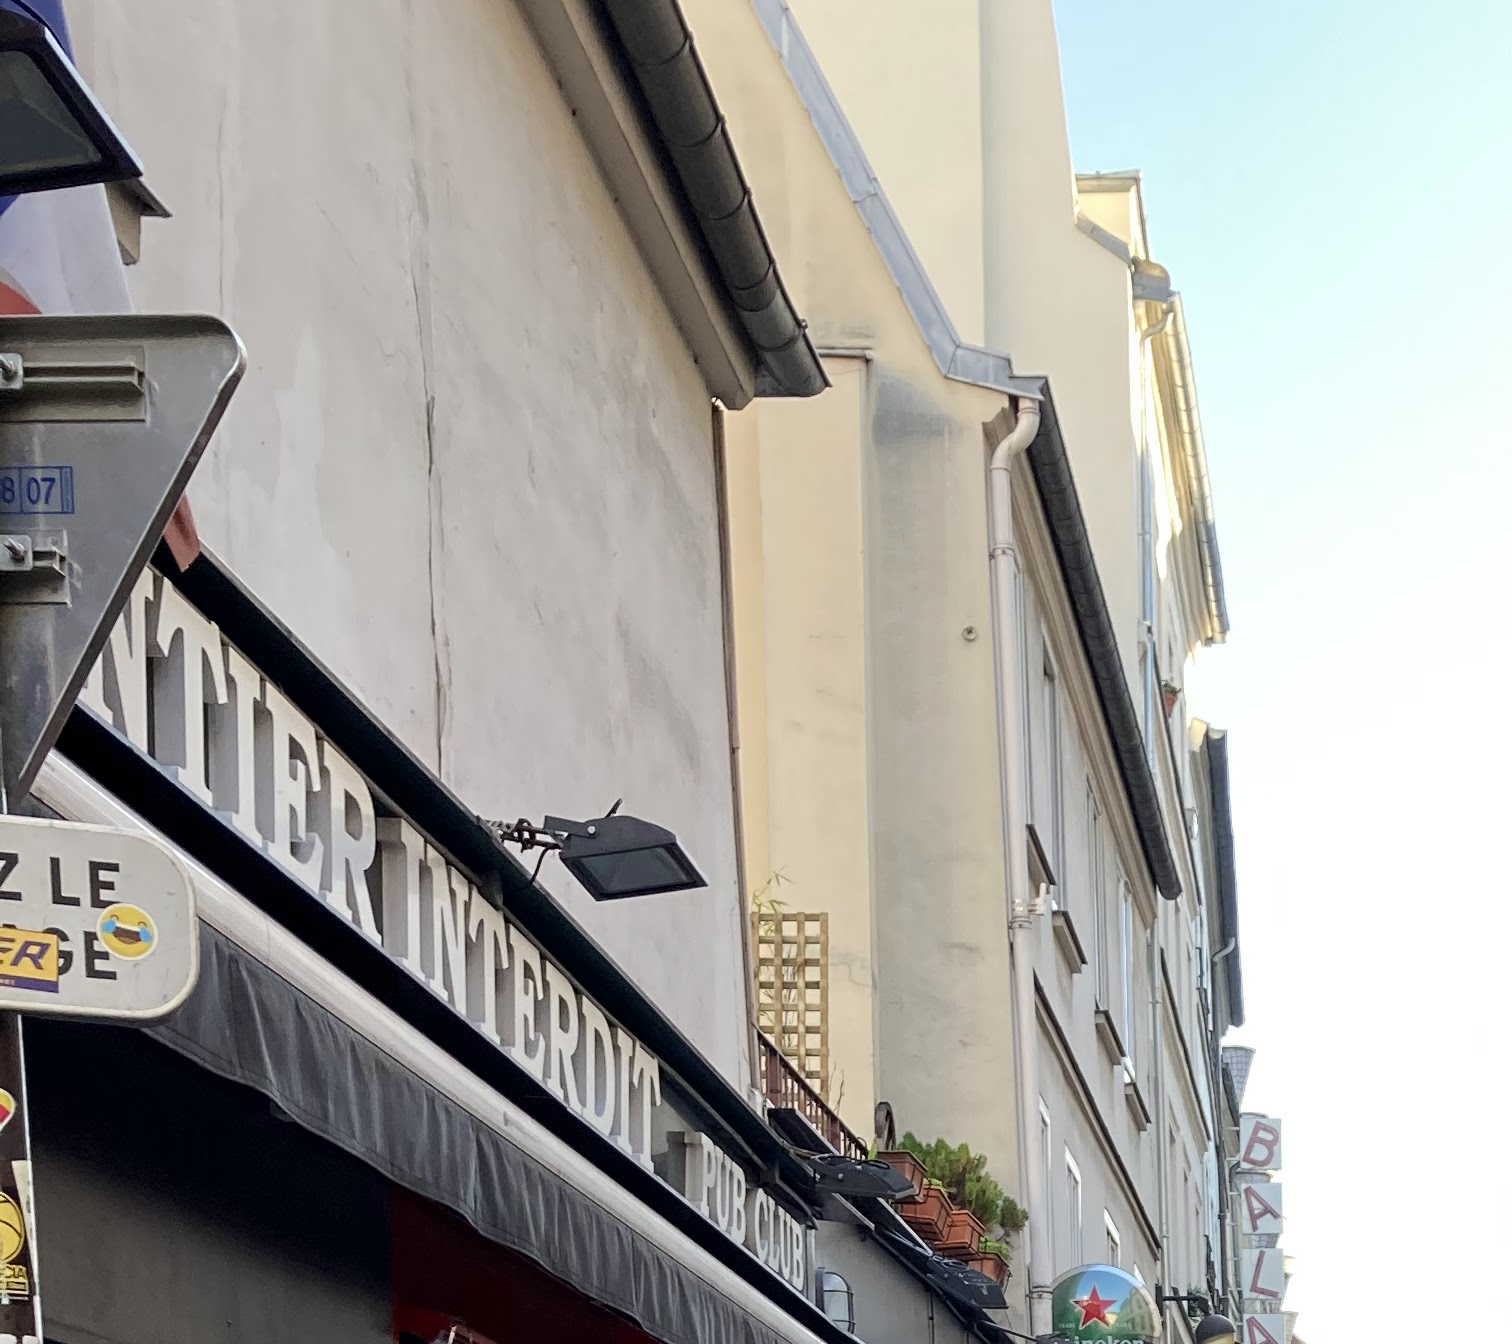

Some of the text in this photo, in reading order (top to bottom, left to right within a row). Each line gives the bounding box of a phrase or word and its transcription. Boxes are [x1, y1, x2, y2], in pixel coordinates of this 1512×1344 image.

[27, 477, 56, 505] 07
[50, 856, 121, 909] LE
[400, 816, 662, 1174] INTERDIT
[700, 1131, 804, 1291] PUB CLUB
